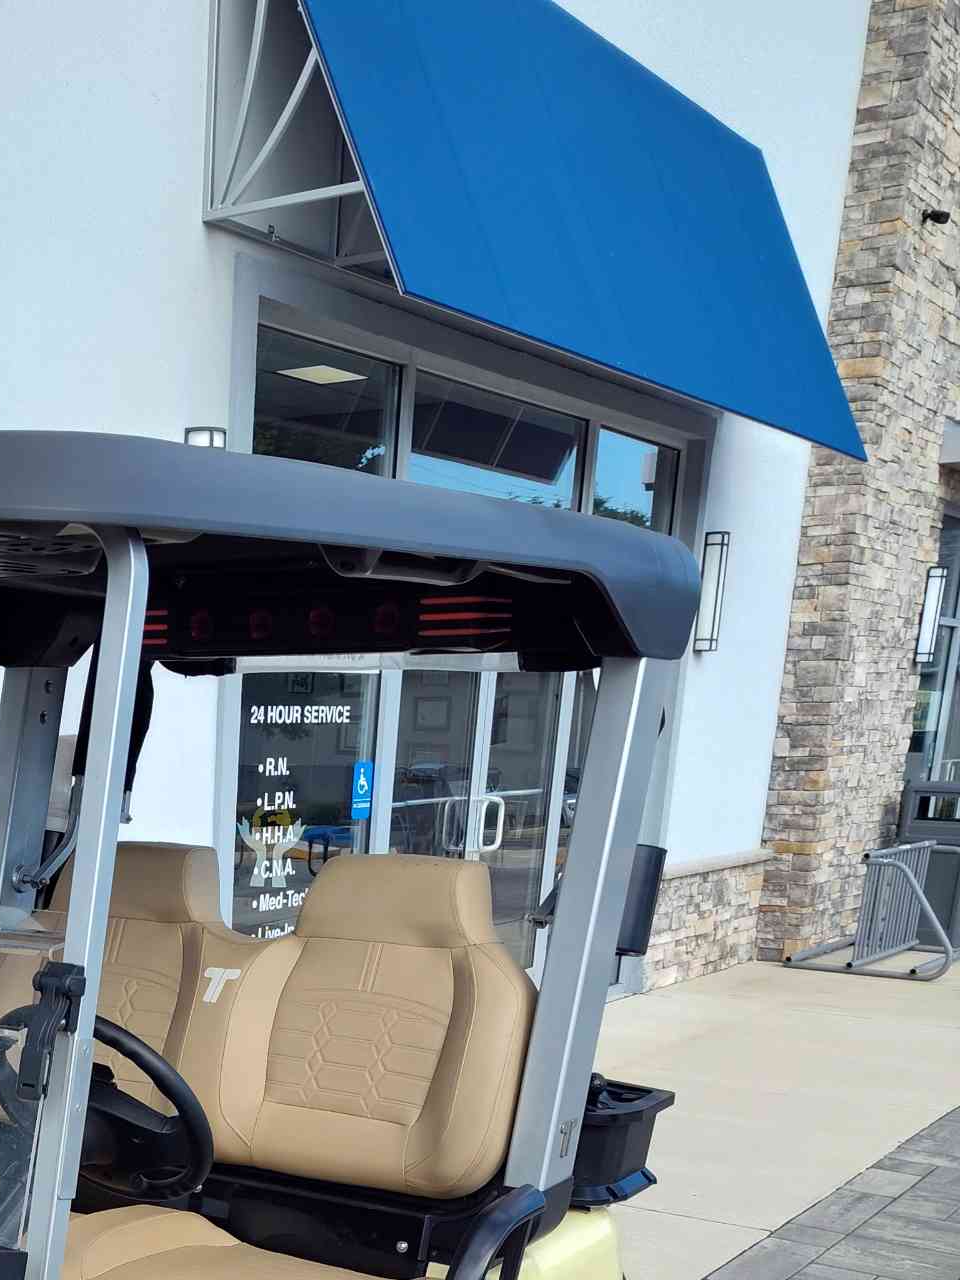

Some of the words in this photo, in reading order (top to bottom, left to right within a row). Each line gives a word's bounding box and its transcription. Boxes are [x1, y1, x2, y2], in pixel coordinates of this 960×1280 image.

[250, 705, 265, 724] 24
[267, 705, 302, 724] HOUR
[303, 705, 351, 724] SERVICE
[265, 757, 290, 776] R.N.
[264, 791, 296, 811] L.P.N.
[260, 858, 296, 878] C.N.A.
